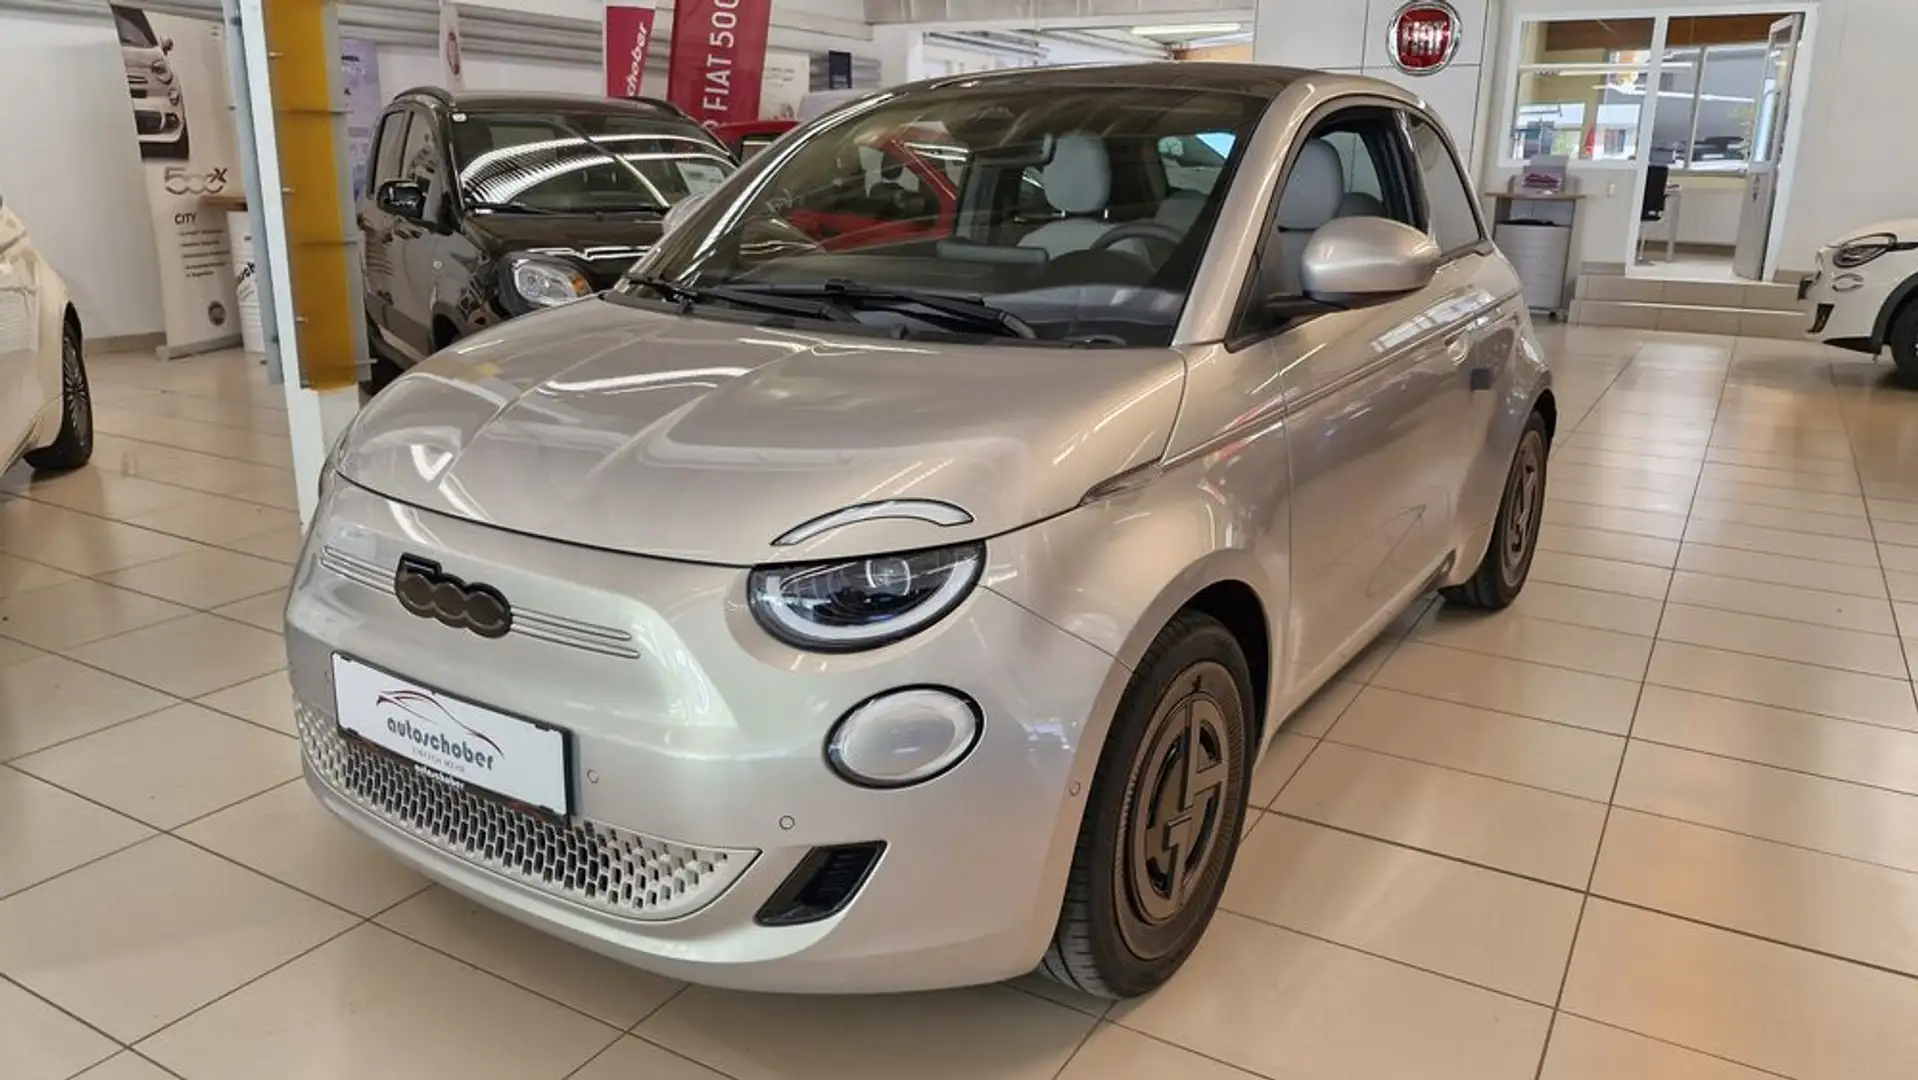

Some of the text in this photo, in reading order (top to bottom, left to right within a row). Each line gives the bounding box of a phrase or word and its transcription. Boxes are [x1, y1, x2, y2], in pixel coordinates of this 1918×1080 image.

[1402, 16, 1450, 55] FIAT
[702, 53, 732, 112] FIAT
[174, 212, 198, 226] CITY
[386, 716, 495, 771] autoschober
